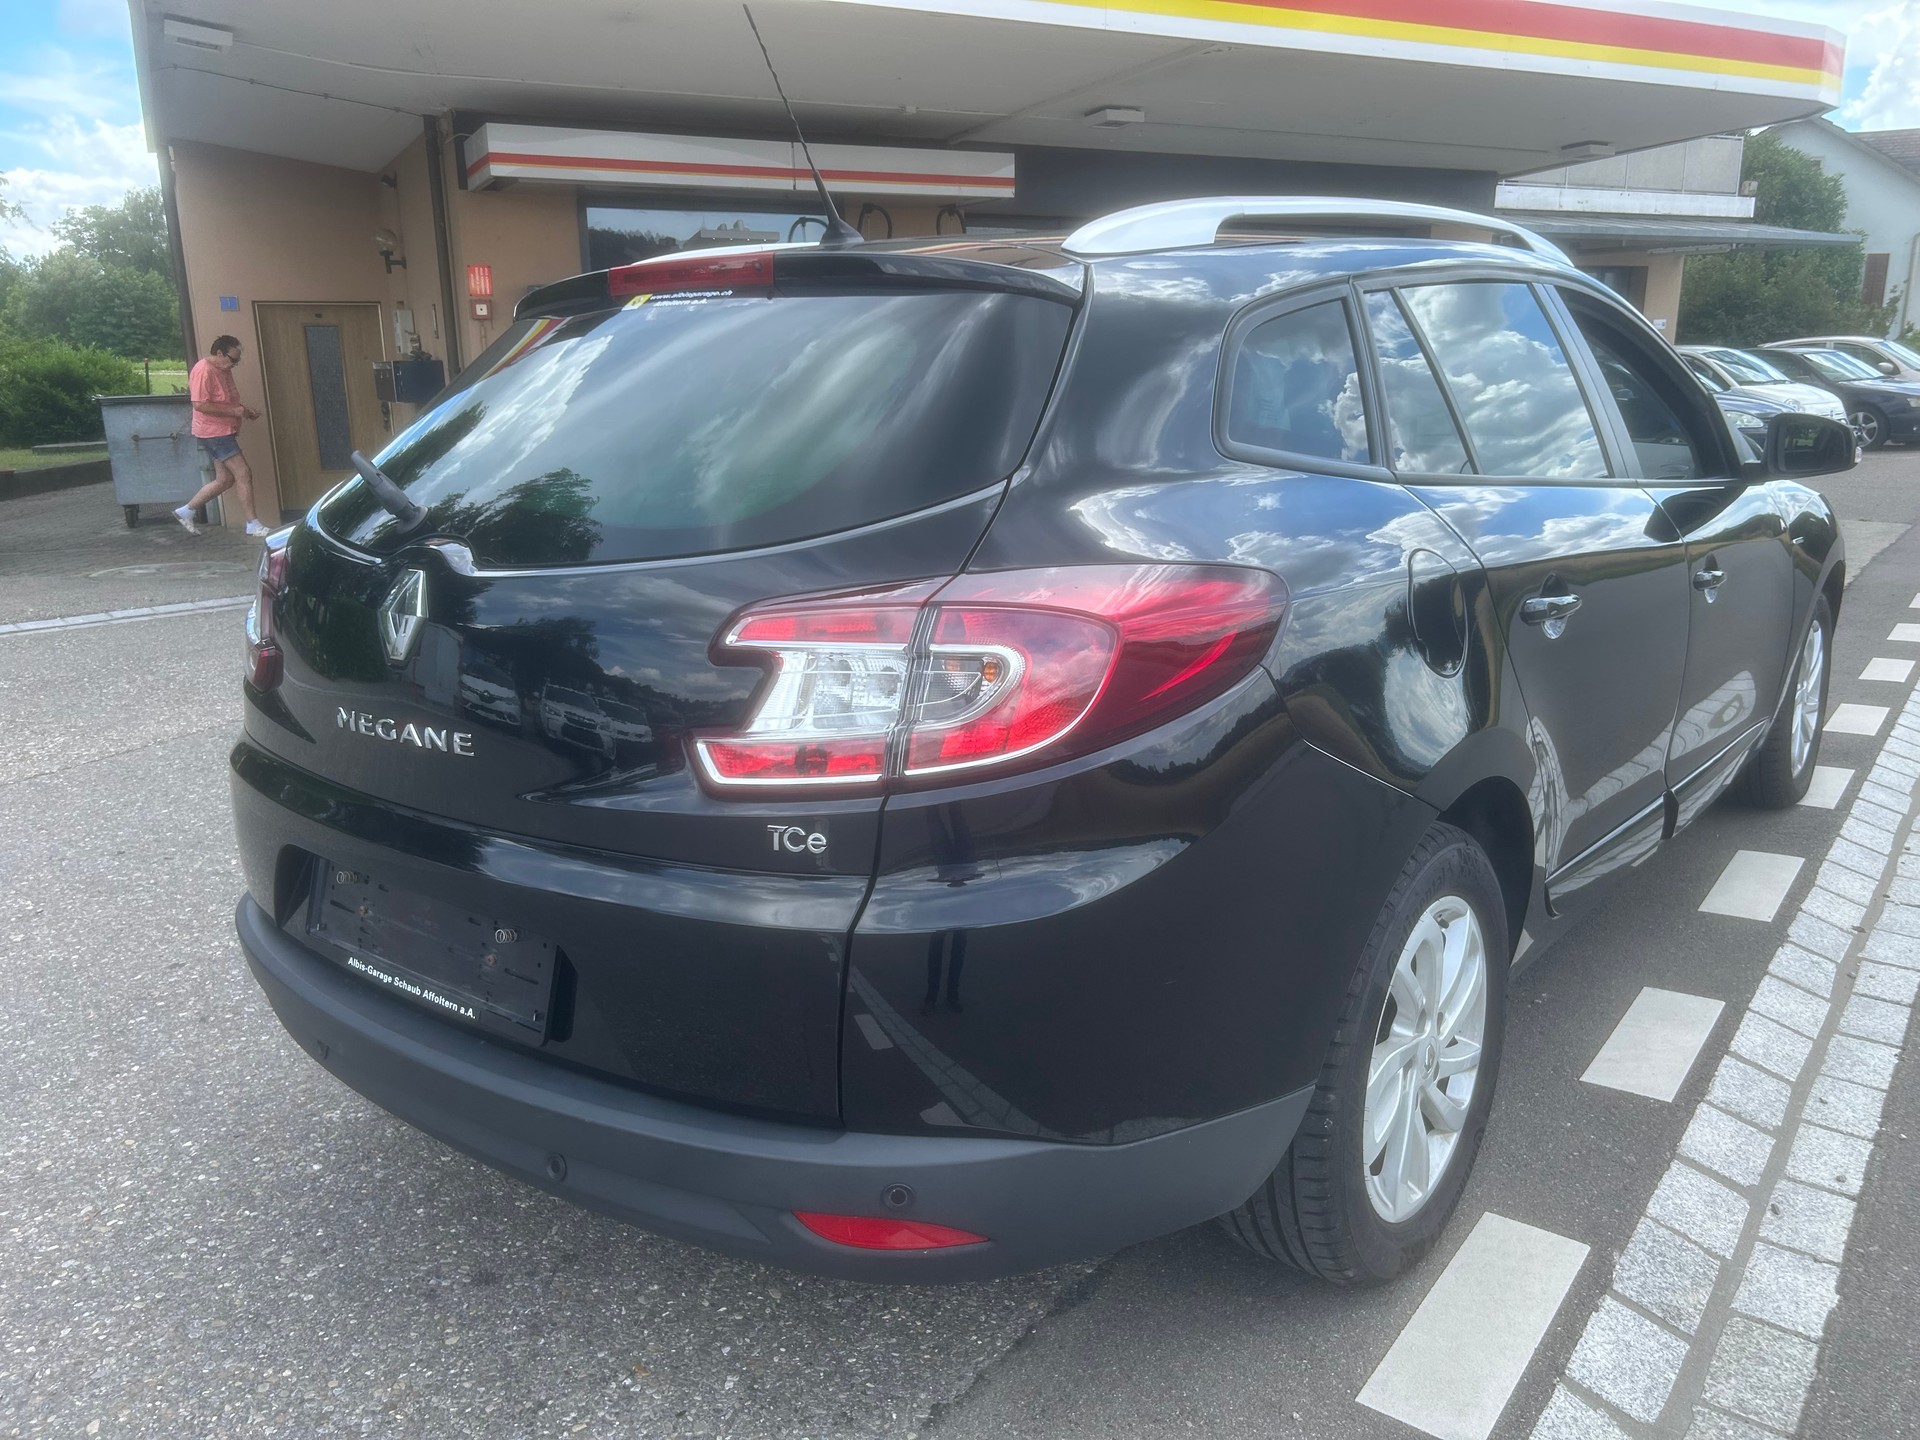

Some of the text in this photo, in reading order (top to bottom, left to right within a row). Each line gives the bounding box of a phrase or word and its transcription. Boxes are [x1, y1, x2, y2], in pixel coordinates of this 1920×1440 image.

[767, 824, 828, 854] TCe
[347, 956, 476, 1020] Albis-Garage Schaub Affoltern a.A.
